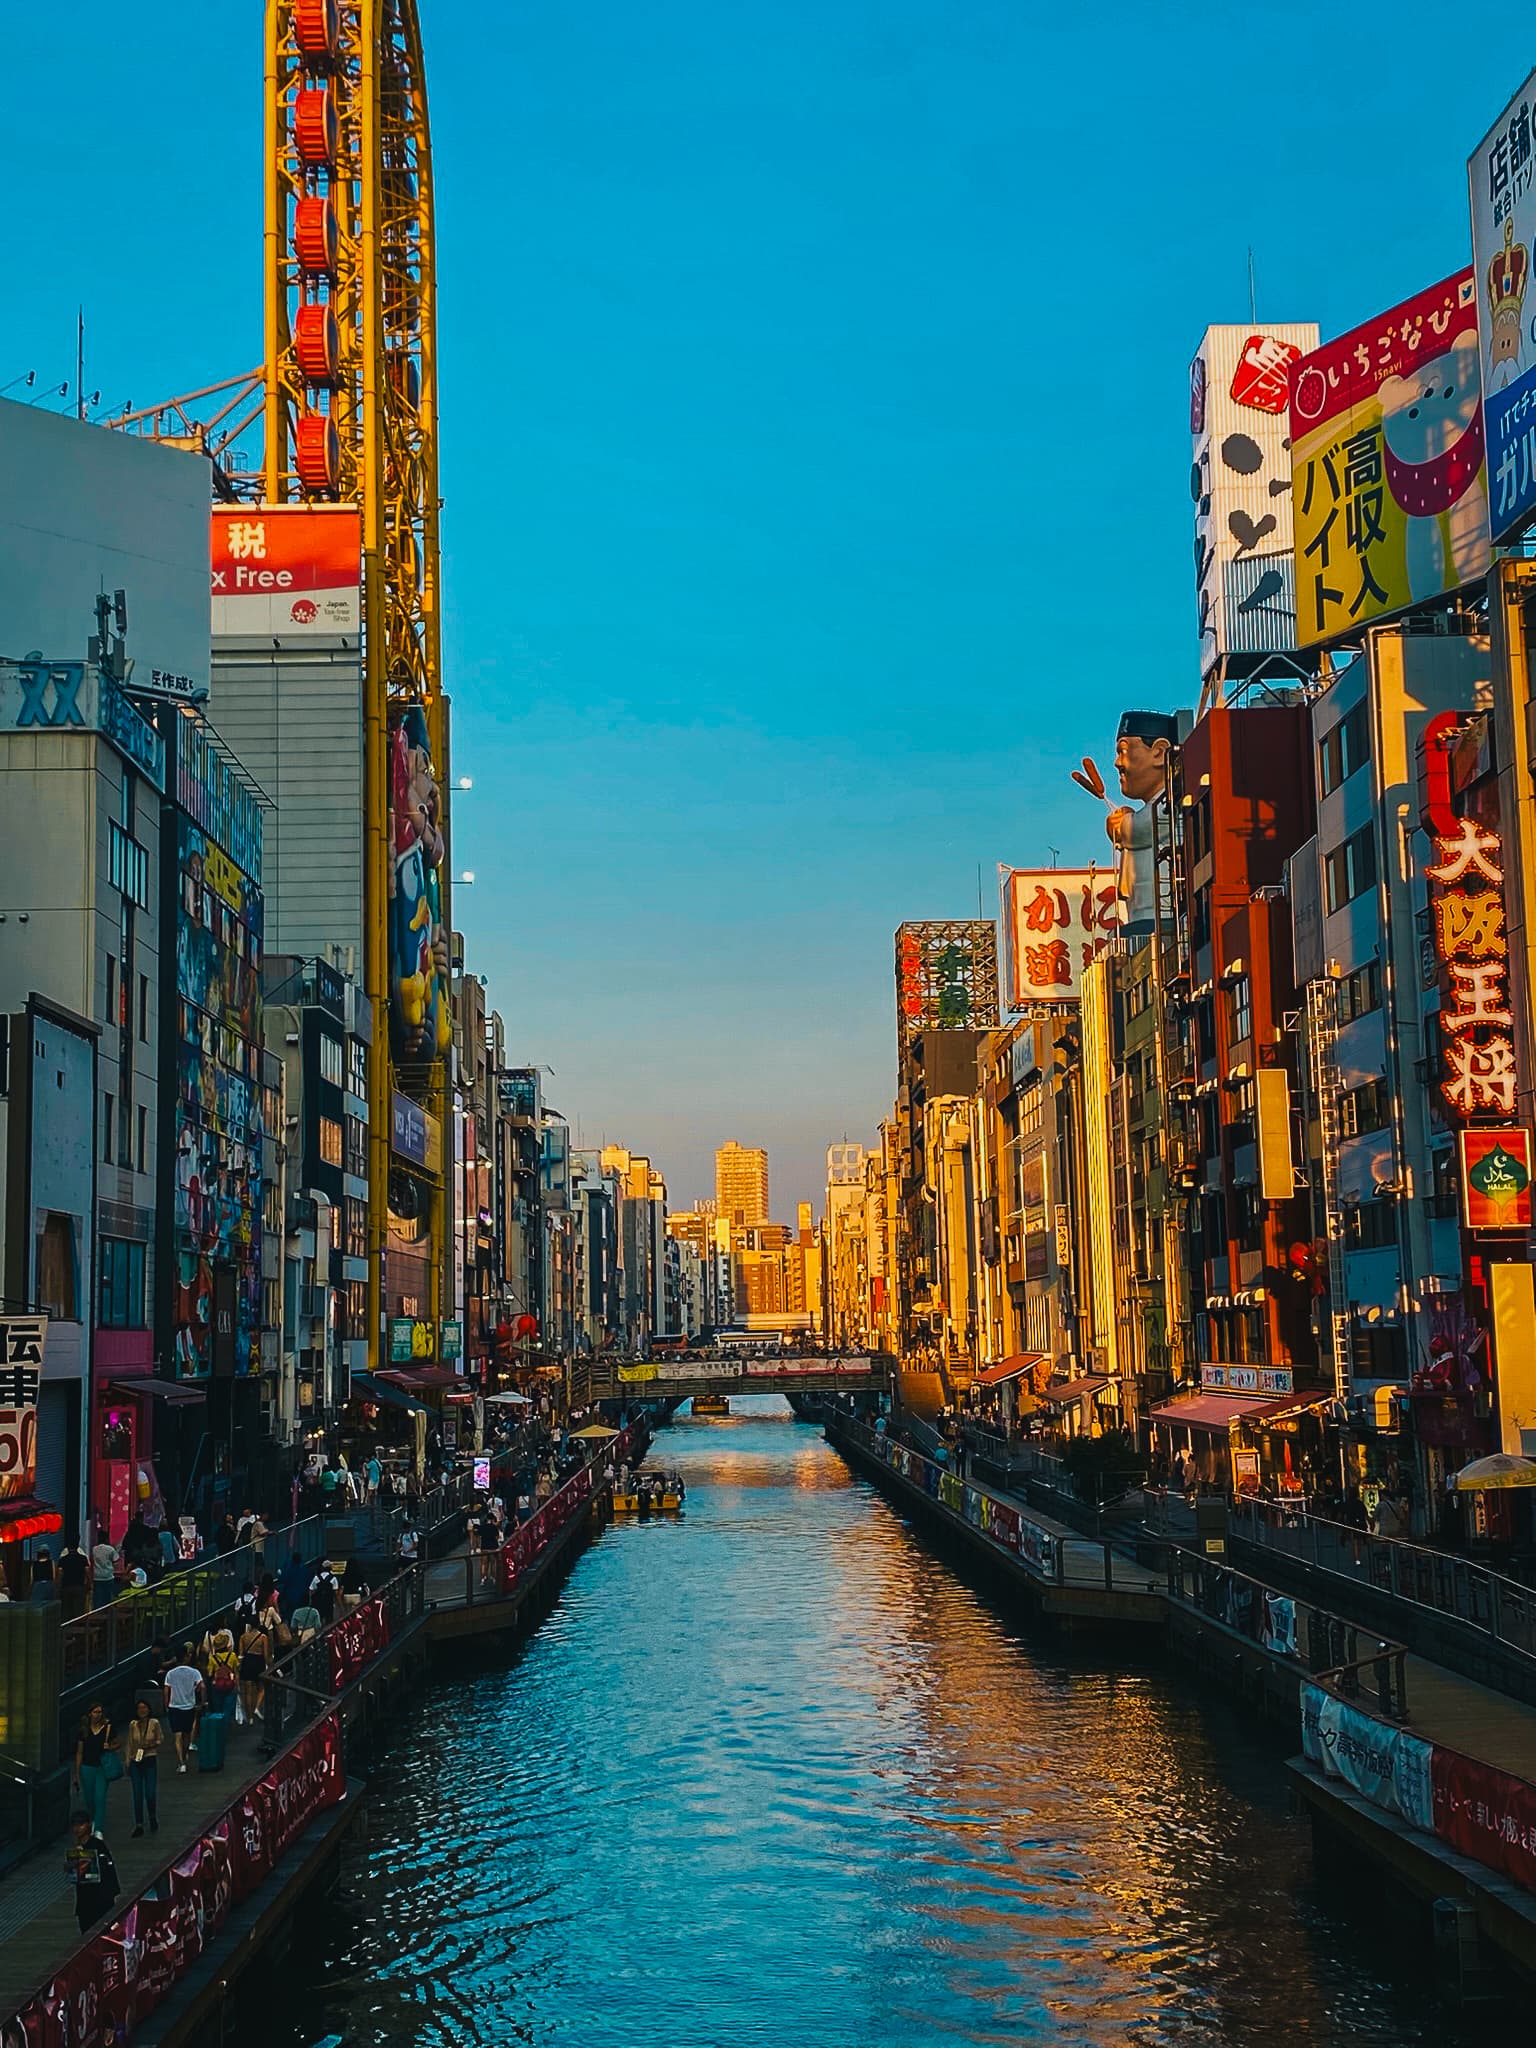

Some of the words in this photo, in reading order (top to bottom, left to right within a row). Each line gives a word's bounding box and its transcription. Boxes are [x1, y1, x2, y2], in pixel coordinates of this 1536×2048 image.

[1489, 101, 1536, 202] 店舗
[1328, 297, 1454, 388] いちごなび
[1374, 361, 1403, 382] 15navi
[228, 522, 266, 559] 税
[1301, 442, 1345, 633] バイト
[1341, 423, 1389, 618] 高収入
[236, 566, 293, 587] Free
[1023, 884, 1124, 933] かに
[1426, 819, 1517, 1114] 大阪王将
[1483, 1166, 1514, 1184] حلال
[1487, 1183, 1513, 1191] HALAL
